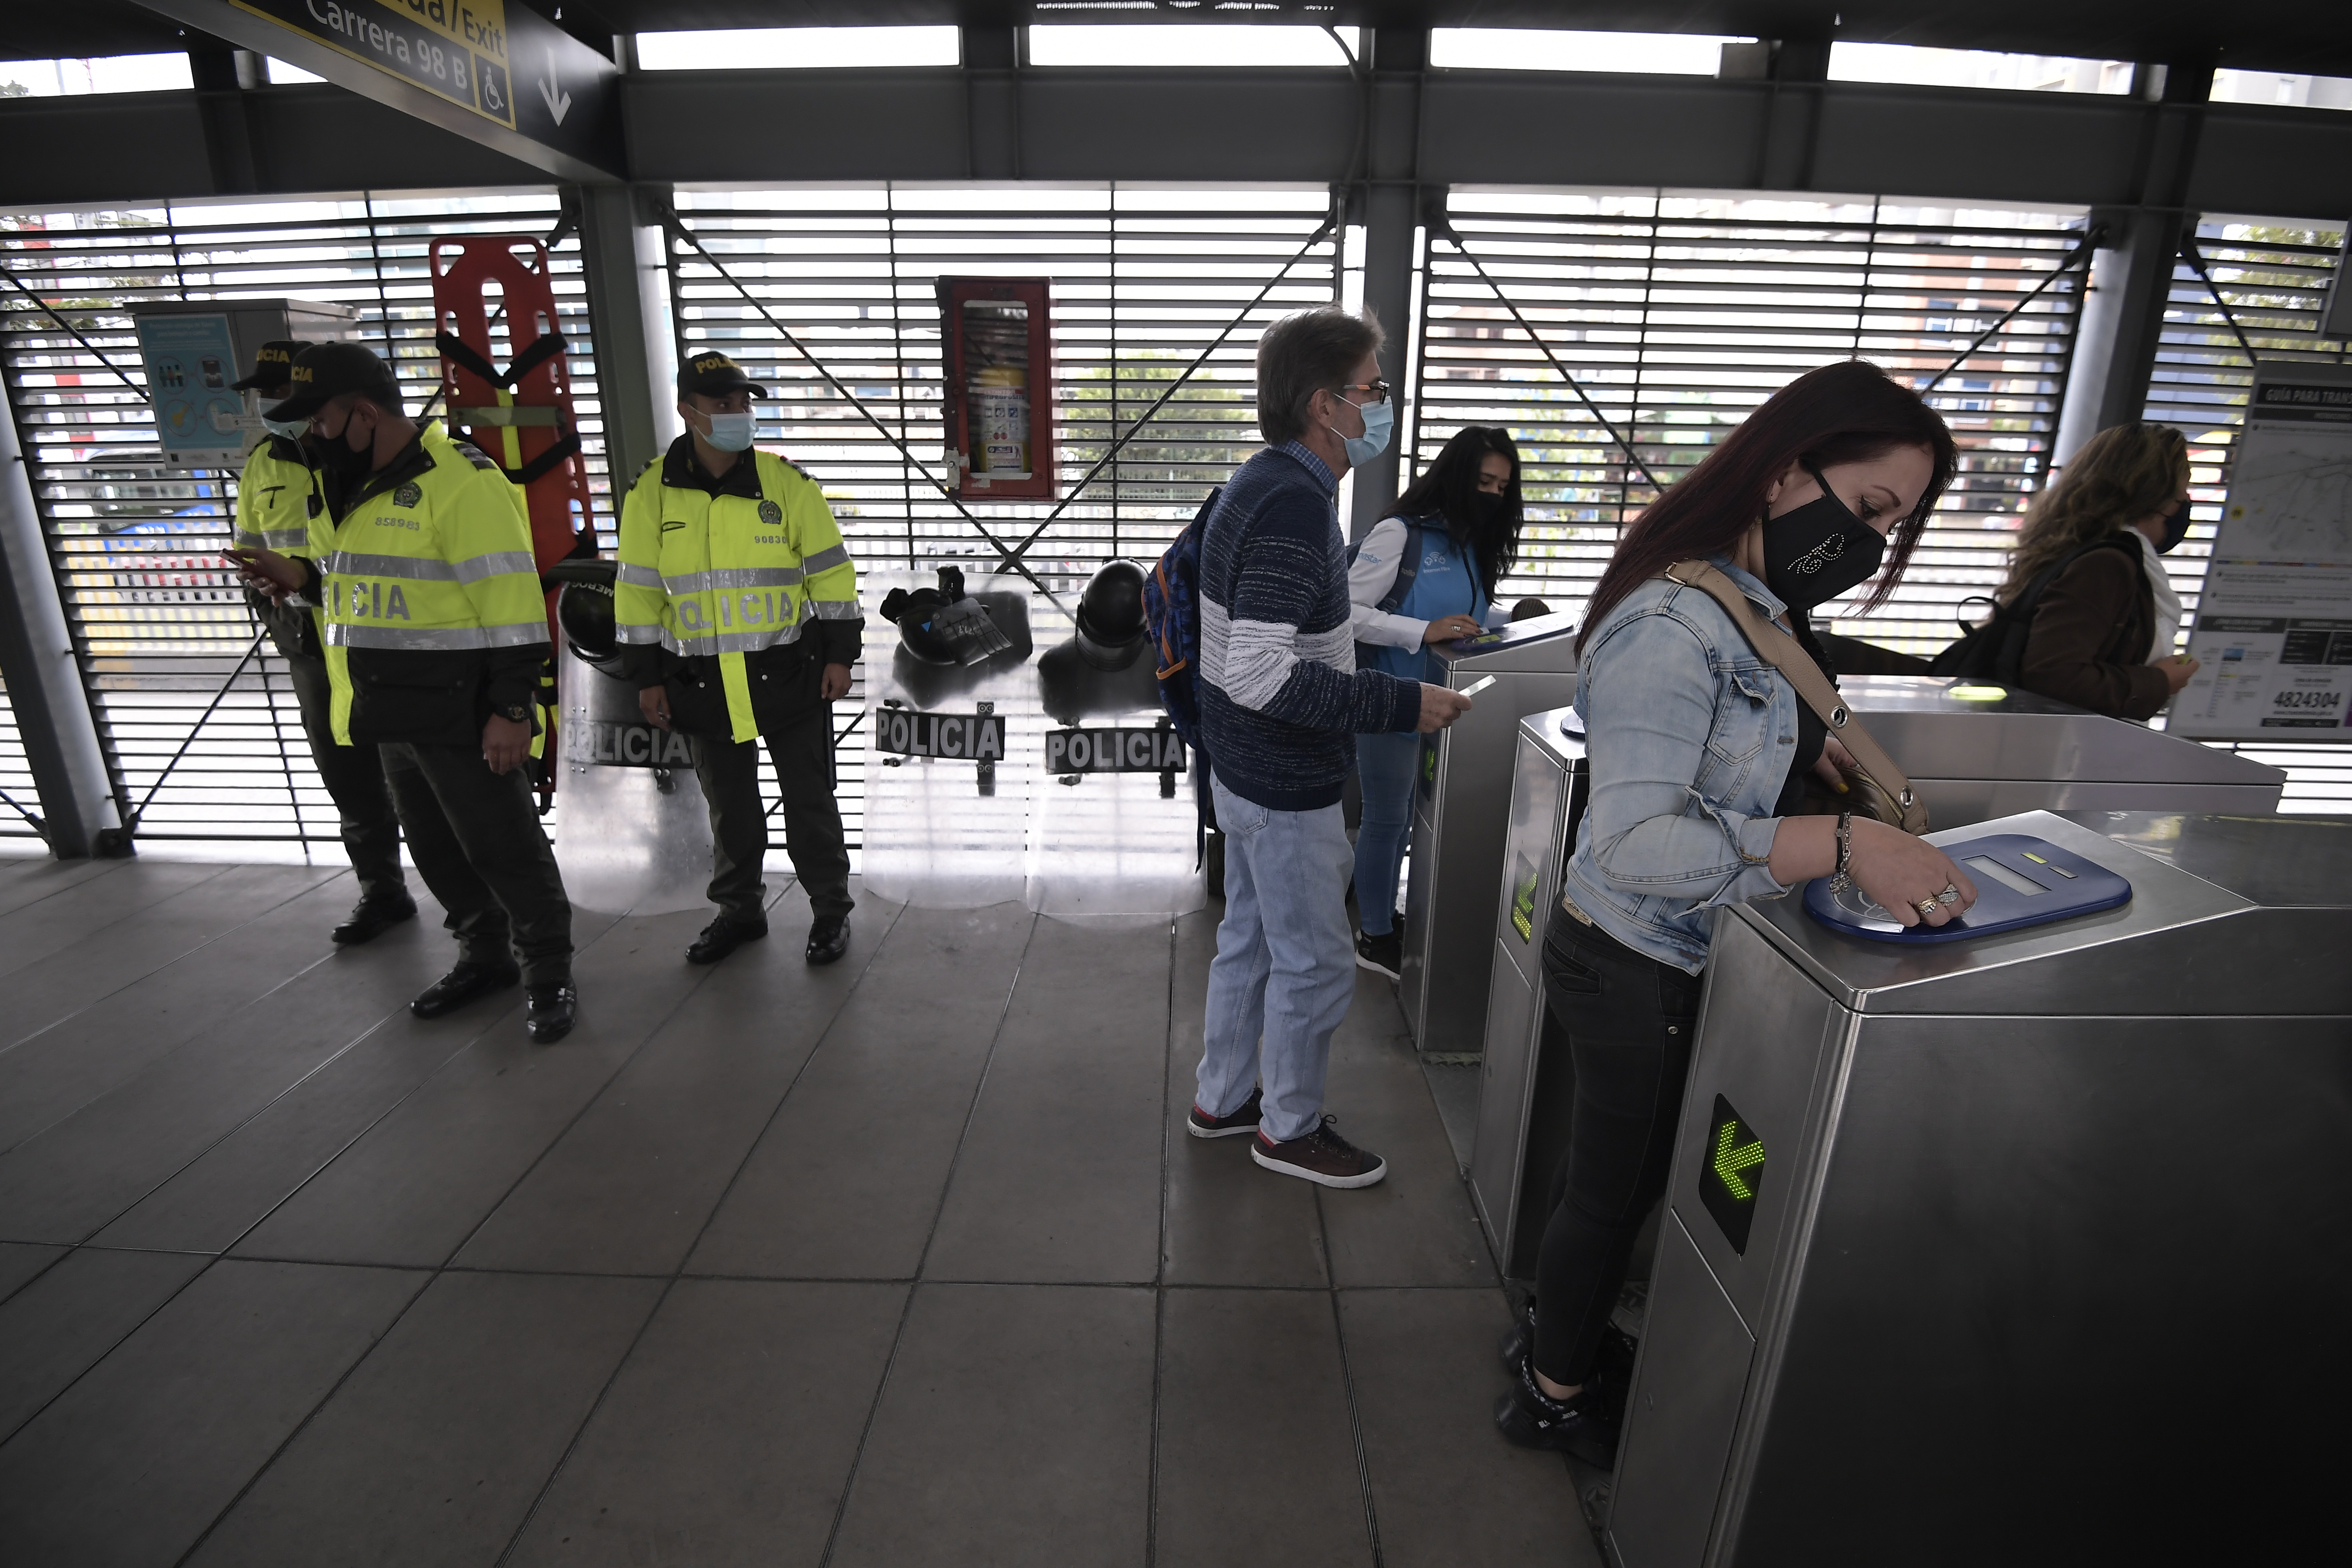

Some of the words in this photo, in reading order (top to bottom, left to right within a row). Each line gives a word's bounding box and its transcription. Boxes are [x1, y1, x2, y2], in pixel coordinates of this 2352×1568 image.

[306, 0, 411, 64] Carrera
[417, 40, 446, 80] 98
[452, 56, 468, 89] B
[256, 348, 291, 363] ICIA
[291, 366, 313, 383] CIA
[2292, 390, 2320, 403] PARA
[322, 581, 411, 620] ICIA
[670, 592, 793, 631] OLICIA
[2273, 691, 2341, 708] 4824304
[565, 723, 691, 763] POLICIA
[877, 711, 1002, 758] POLICIA
[1048, 732, 1185, 769] POLICIA
